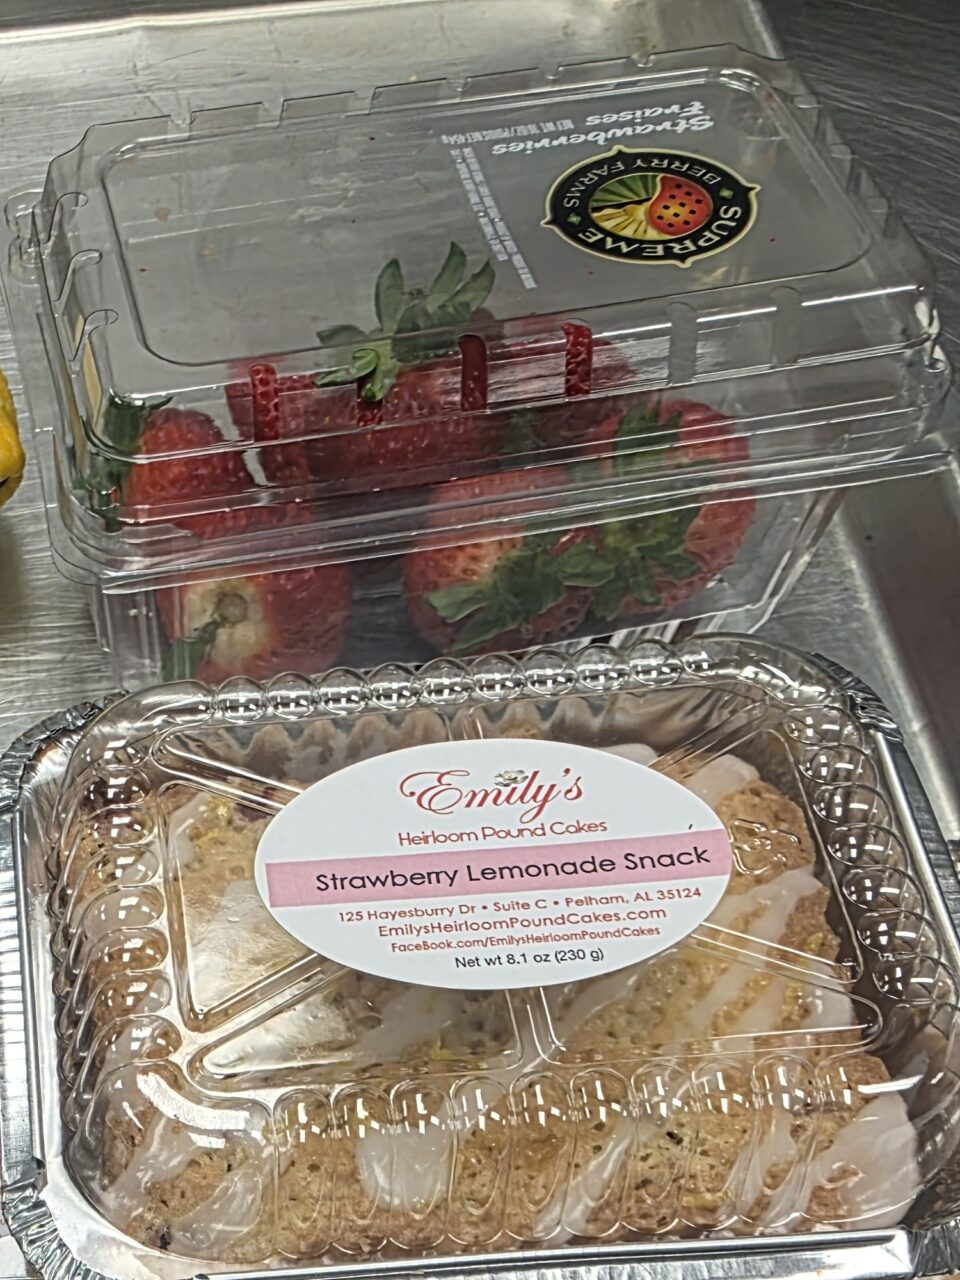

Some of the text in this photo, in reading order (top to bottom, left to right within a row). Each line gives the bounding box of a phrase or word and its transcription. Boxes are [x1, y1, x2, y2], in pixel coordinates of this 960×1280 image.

[585, 101, 705, 126] Fraises
[490, 115, 714, 154] Strawberries
[563, 157, 722, 208] BERRY FARMS
[578, 205, 741, 256] SUPREME
[399, 767, 582, 824] Emily's
[399, 820, 608, 846] Heirloom Pound Cakes
[316, 846, 711, 891] Strawberry Lemonade Snack
[339, 887, 702, 922] 125 Hayesburry Dr Suite C Pelham, AL 35124
[379, 908, 666, 937] EmilysHeirloomPoundCakes.com
[392, 926, 660, 953] FaceBook.com/EmilysHeirloomPoundCakes
[455, 948, 604, 968] Net wt 8.1 oz (230 g)
